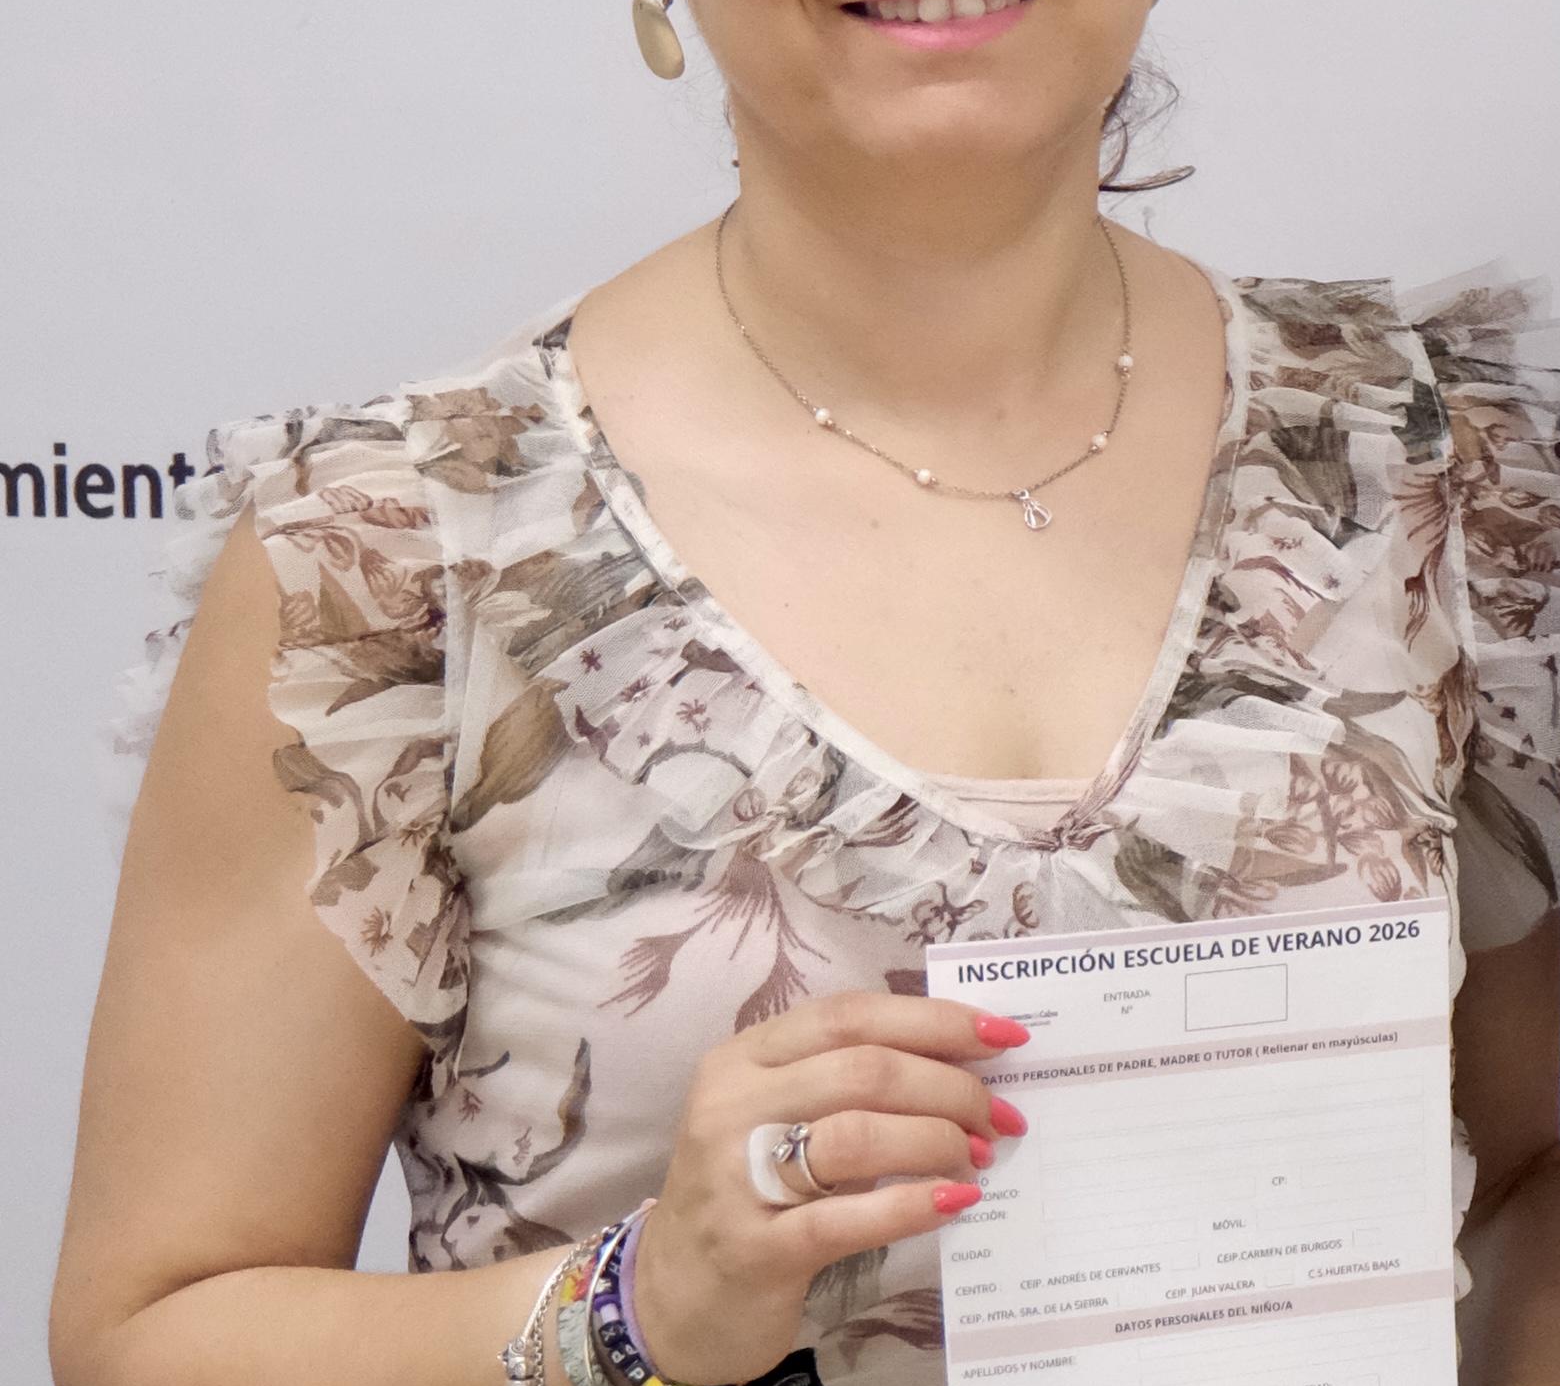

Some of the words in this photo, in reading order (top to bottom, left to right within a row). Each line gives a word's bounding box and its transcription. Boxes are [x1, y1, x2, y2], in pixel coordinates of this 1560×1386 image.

[958, 948, 1115, 984] INSCRIPCIÓN
[1124, 940, 1225, 969] ESCUELA
[1231, 937, 1260, 958] DE
[1266, 926, 1362, 953] VERANO
[1368, 919, 1420, 943] 2026
[1103, 988, 1151, 1004] ENTRADA
[980, 1073, 1020, 1088] DATOS
[1022, 1064, 1096, 1082] PERSONALES
[1098, 1062, 1113, 1074] DE
[1159, 1052, 1200, 1067] MADRE
[1203, 1051, 1213, 1062] O
[1215, 1047, 1253, 1061] TUTOR
[1311, 1041, 1326, 1050] en
[1328, 1031, 1398, 1049] mayúsculas)
[1114, 1318, 1153, 1334] DATOS
[1154, 1309, 1225, 1329] PERSONALES
[1227, 1306, 1248, 1318] DEL
[1250, 1300, 1293, 1315] NIÑO/A
